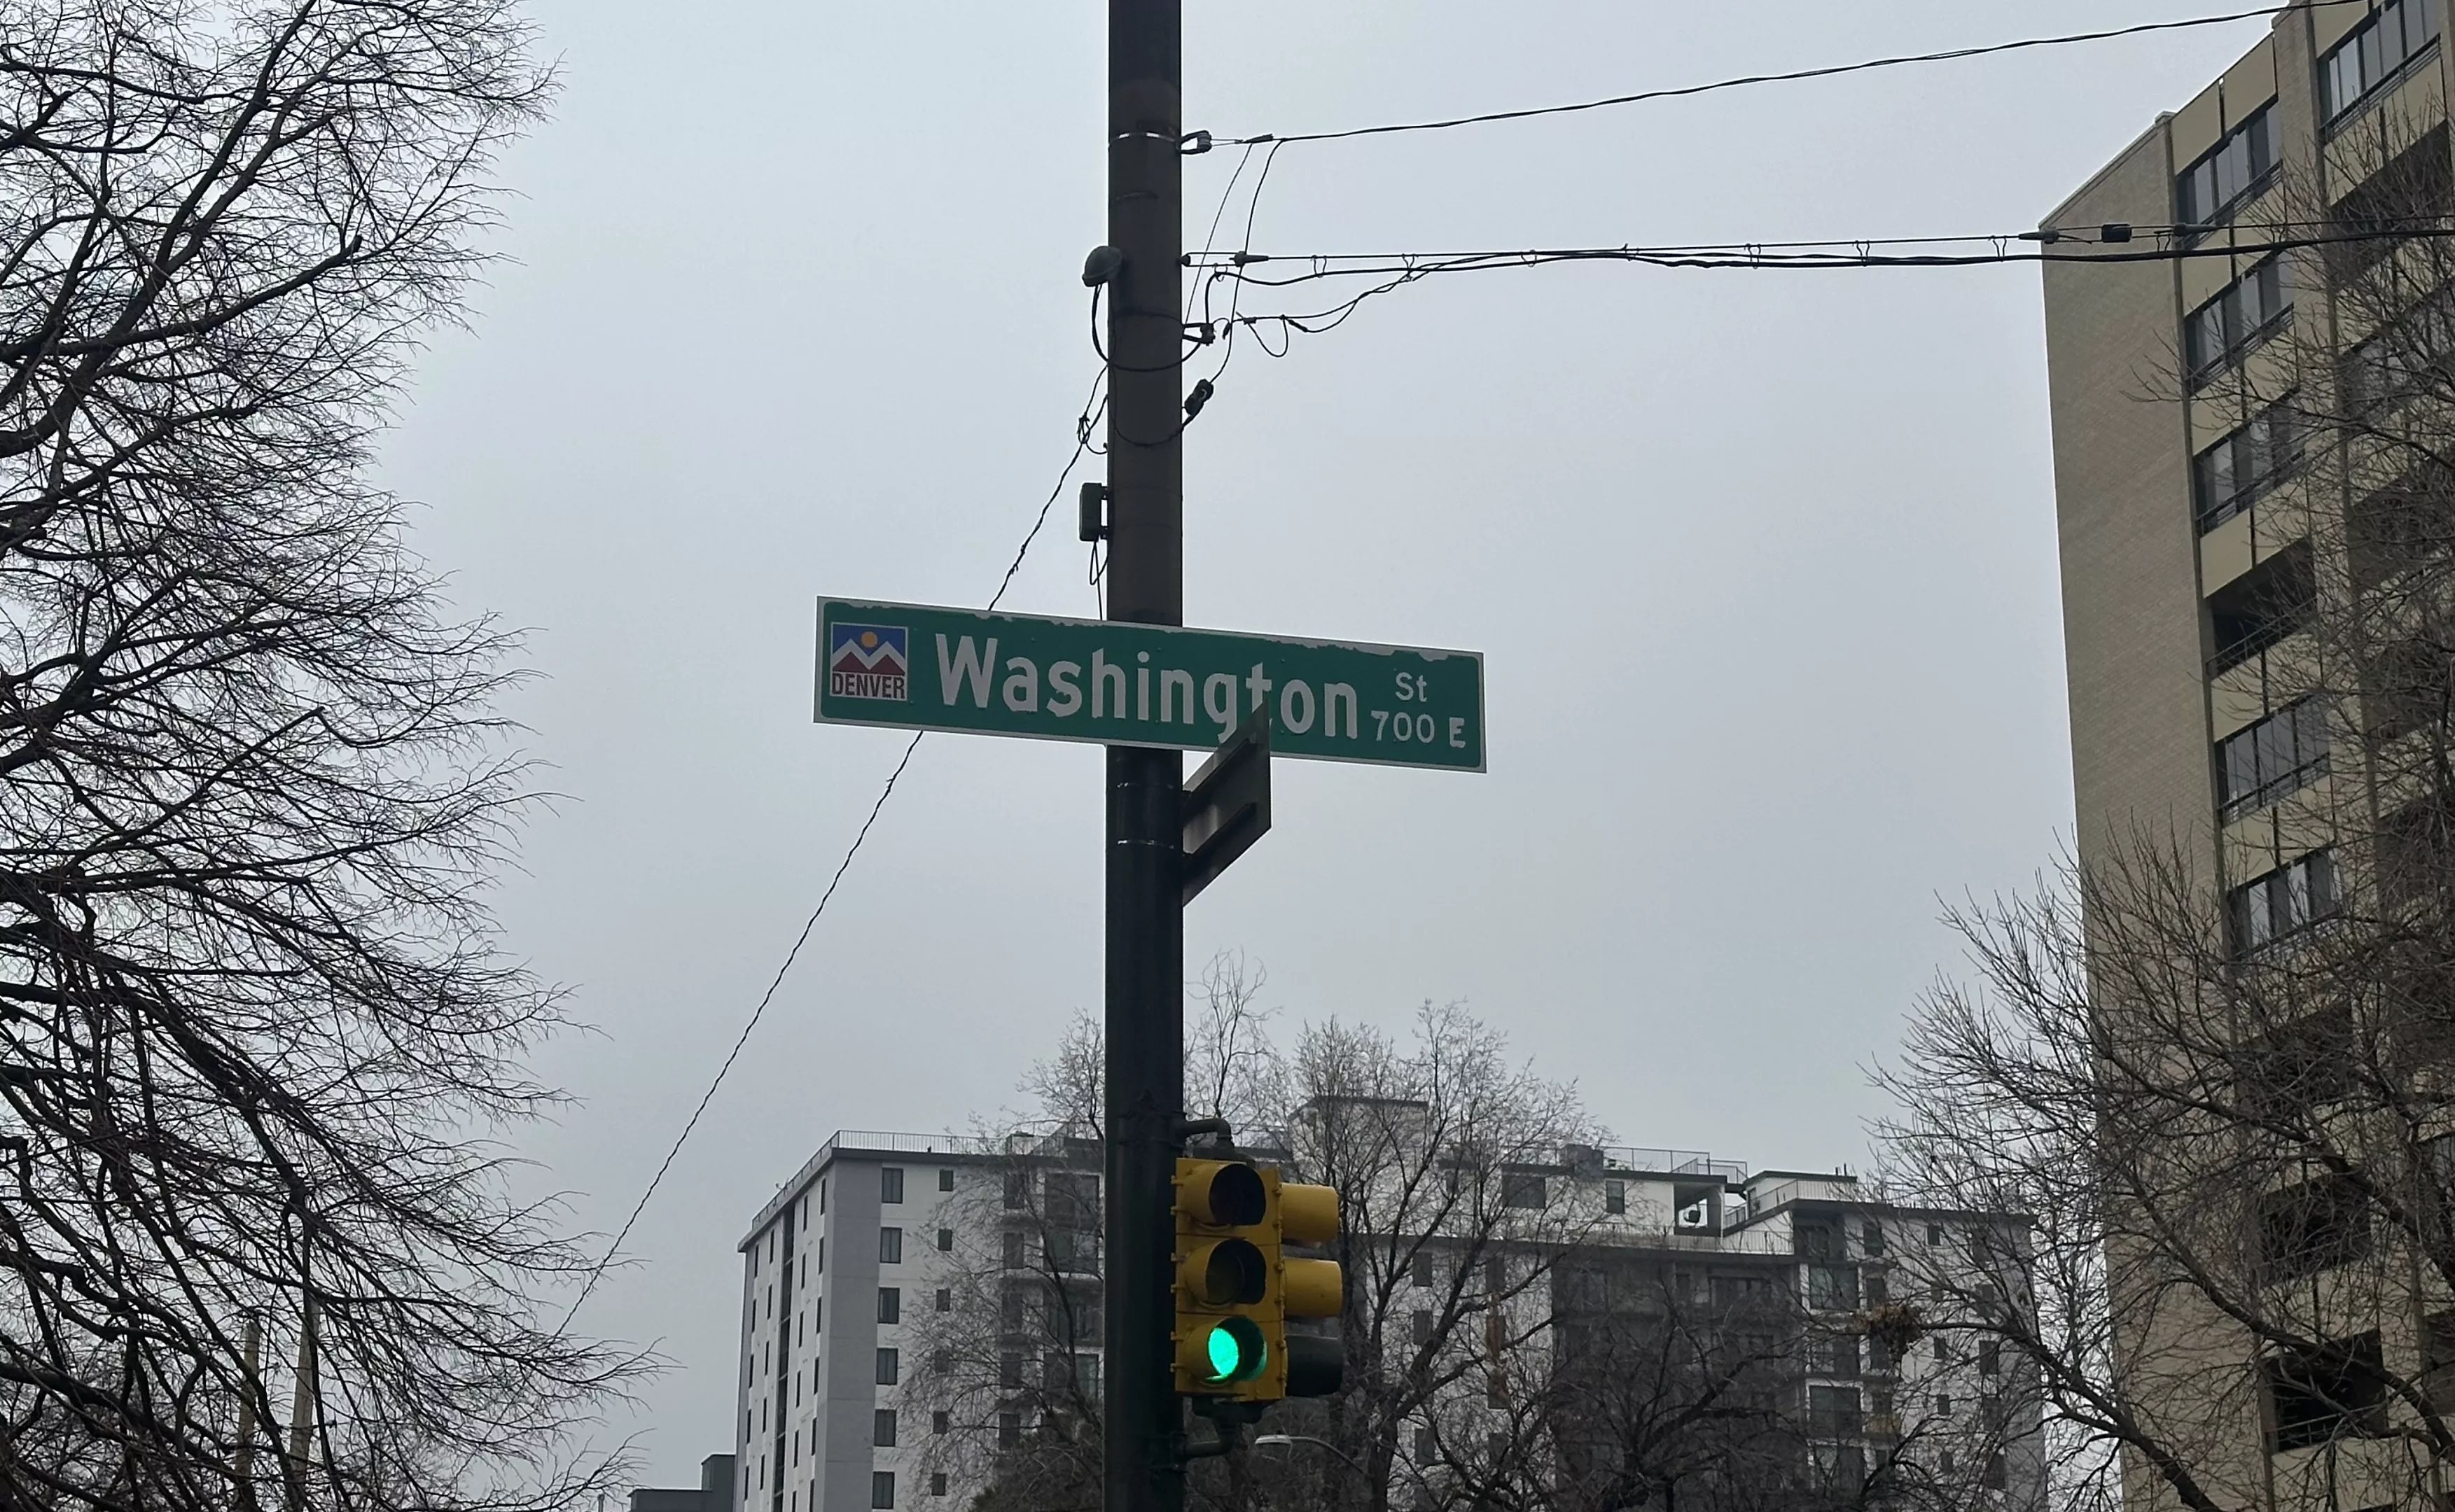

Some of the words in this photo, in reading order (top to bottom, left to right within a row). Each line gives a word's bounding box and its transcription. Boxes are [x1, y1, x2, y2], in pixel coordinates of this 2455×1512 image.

[831, 672, 906, 699] DENVER
[935, 634, 1357, 743] Washington
[1396, 672, 1428, 702] St
[1370, 710, 1435, 743] 700
[1449, 717, 1466, 748] E
